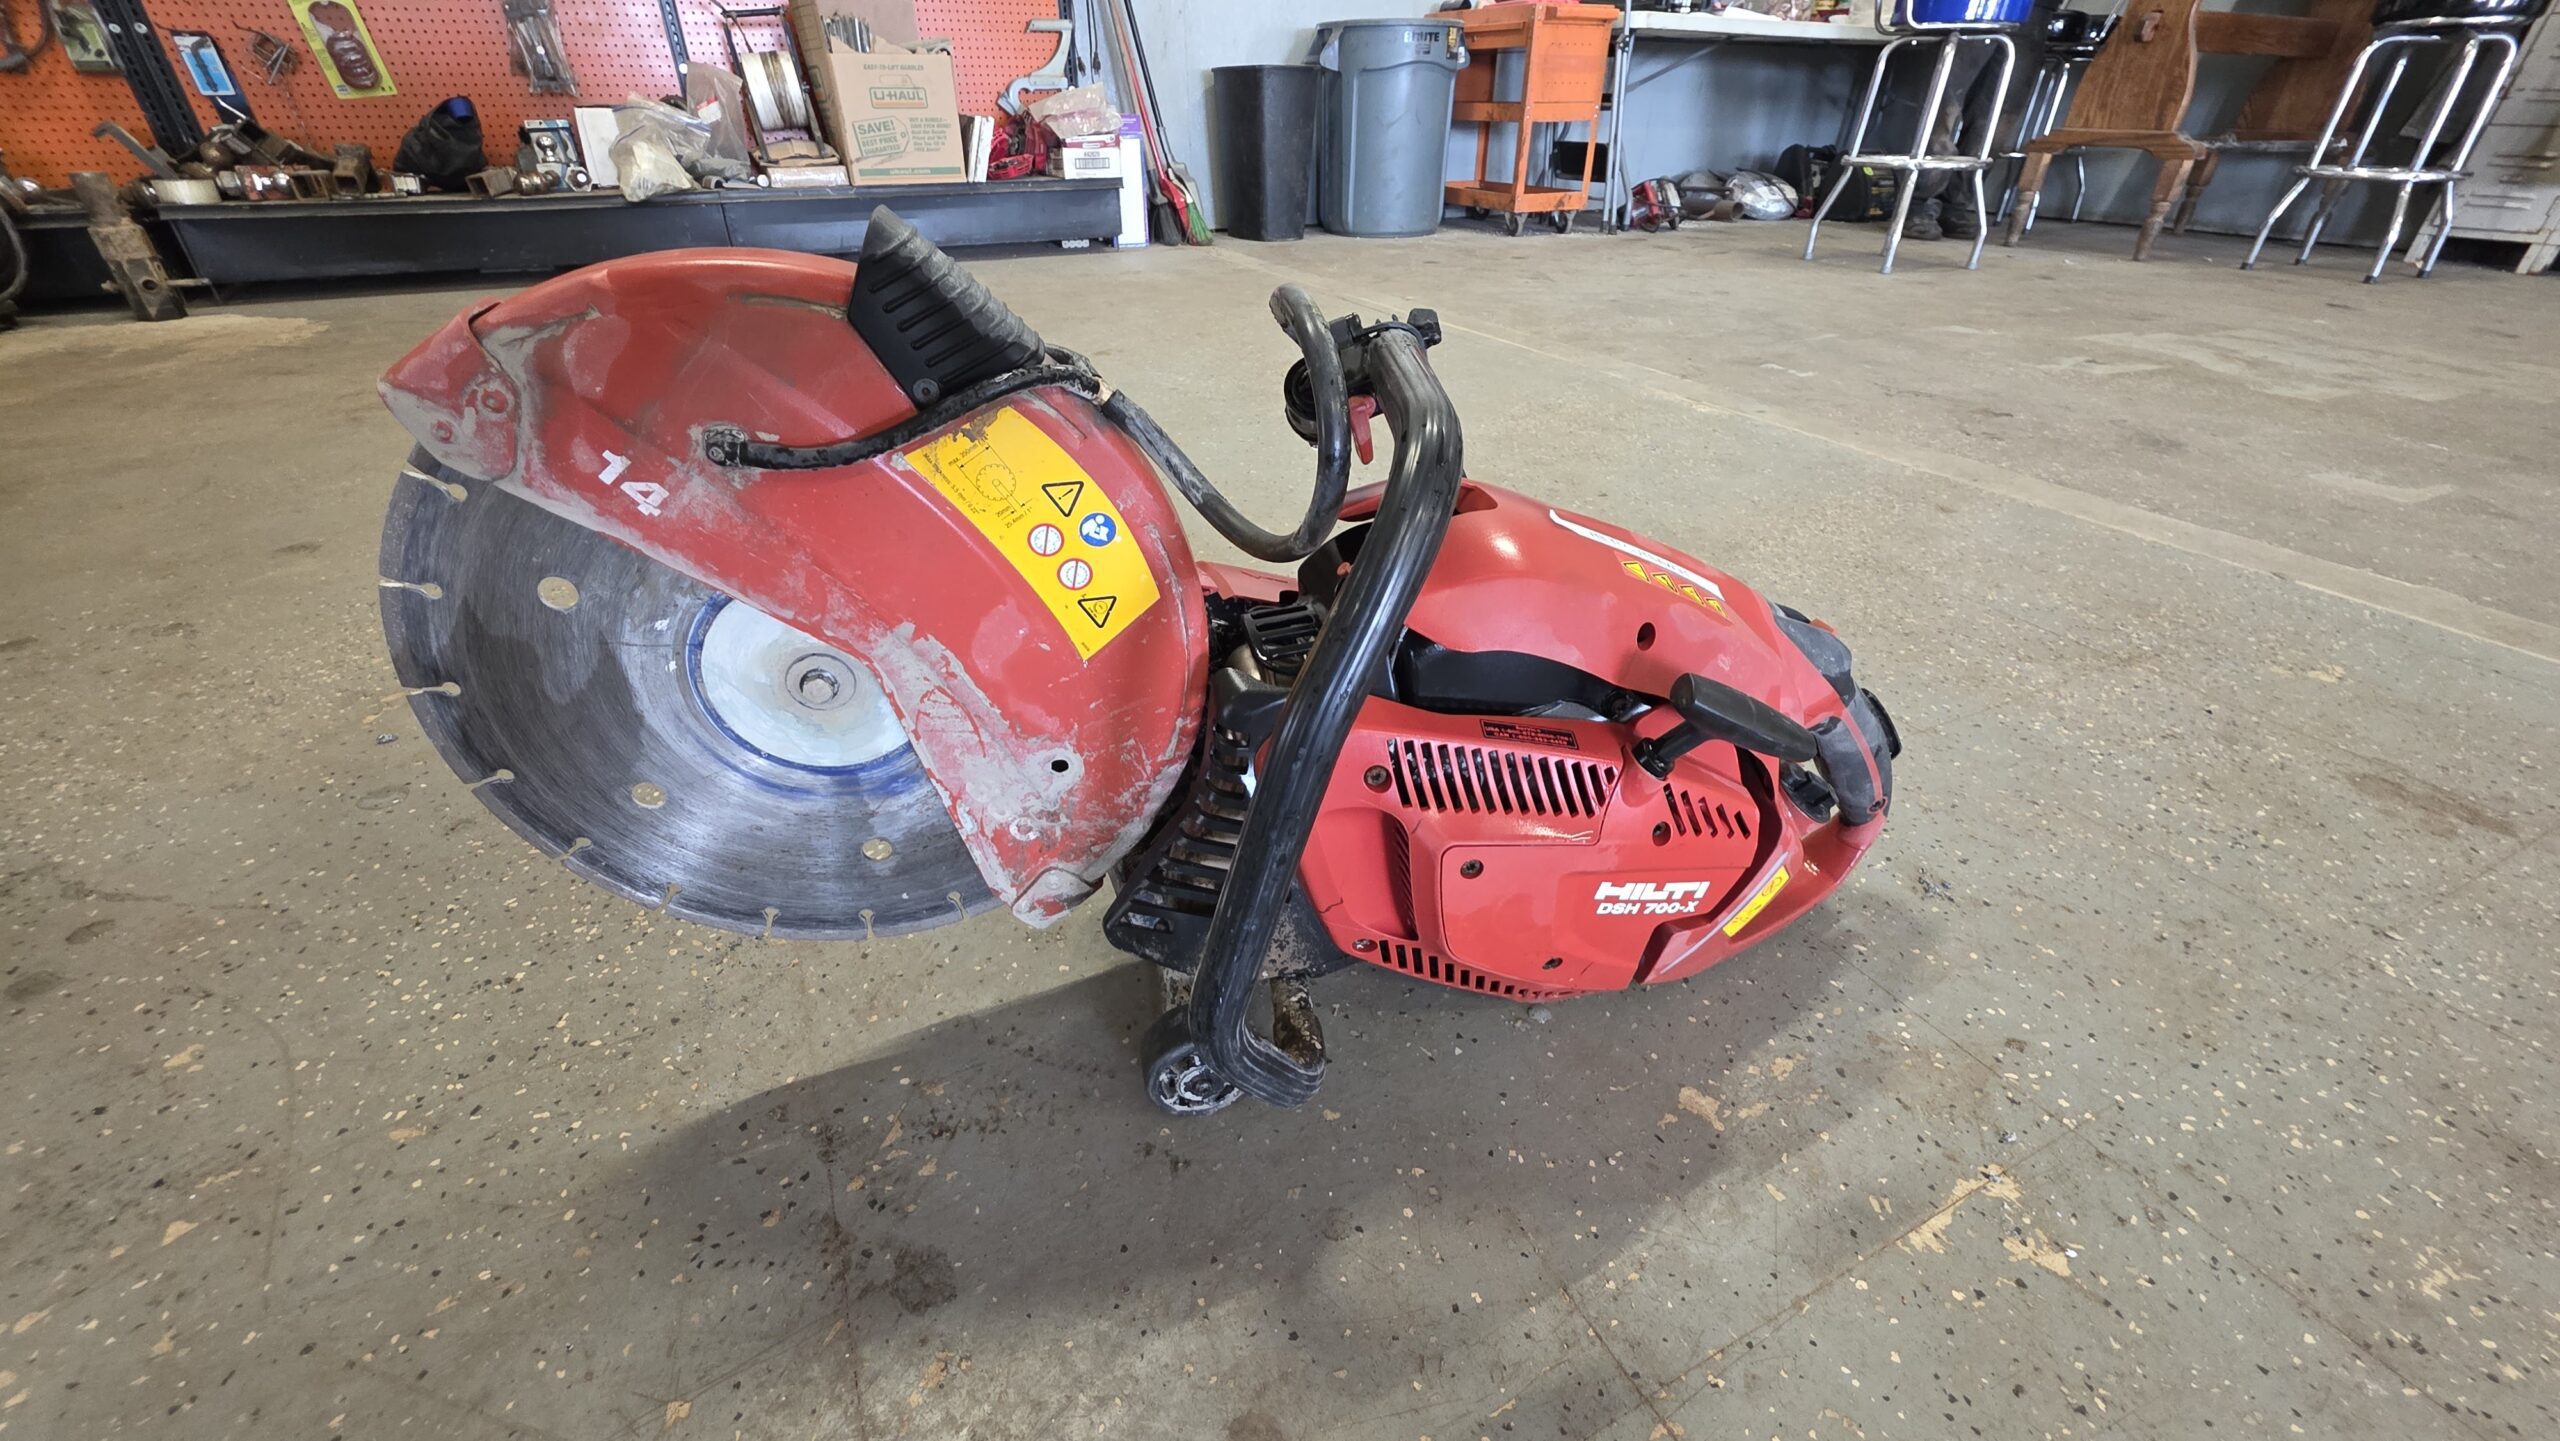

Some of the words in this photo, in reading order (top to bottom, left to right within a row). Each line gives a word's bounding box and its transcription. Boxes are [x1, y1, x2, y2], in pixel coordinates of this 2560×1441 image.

[873, 90, 924, 101] U-HAUL
[857, 119, 896, 135] SAVE!
[861, 138, 879, 148] BEST
[879, 135, 898, 145] PRICE
[598, 449, 670, 517] 14
[1594, 881, 1711, 900] HILTI
[1596, 902, 1641, 915] DSH
[1643, 901, 1699, 915] 700-X
